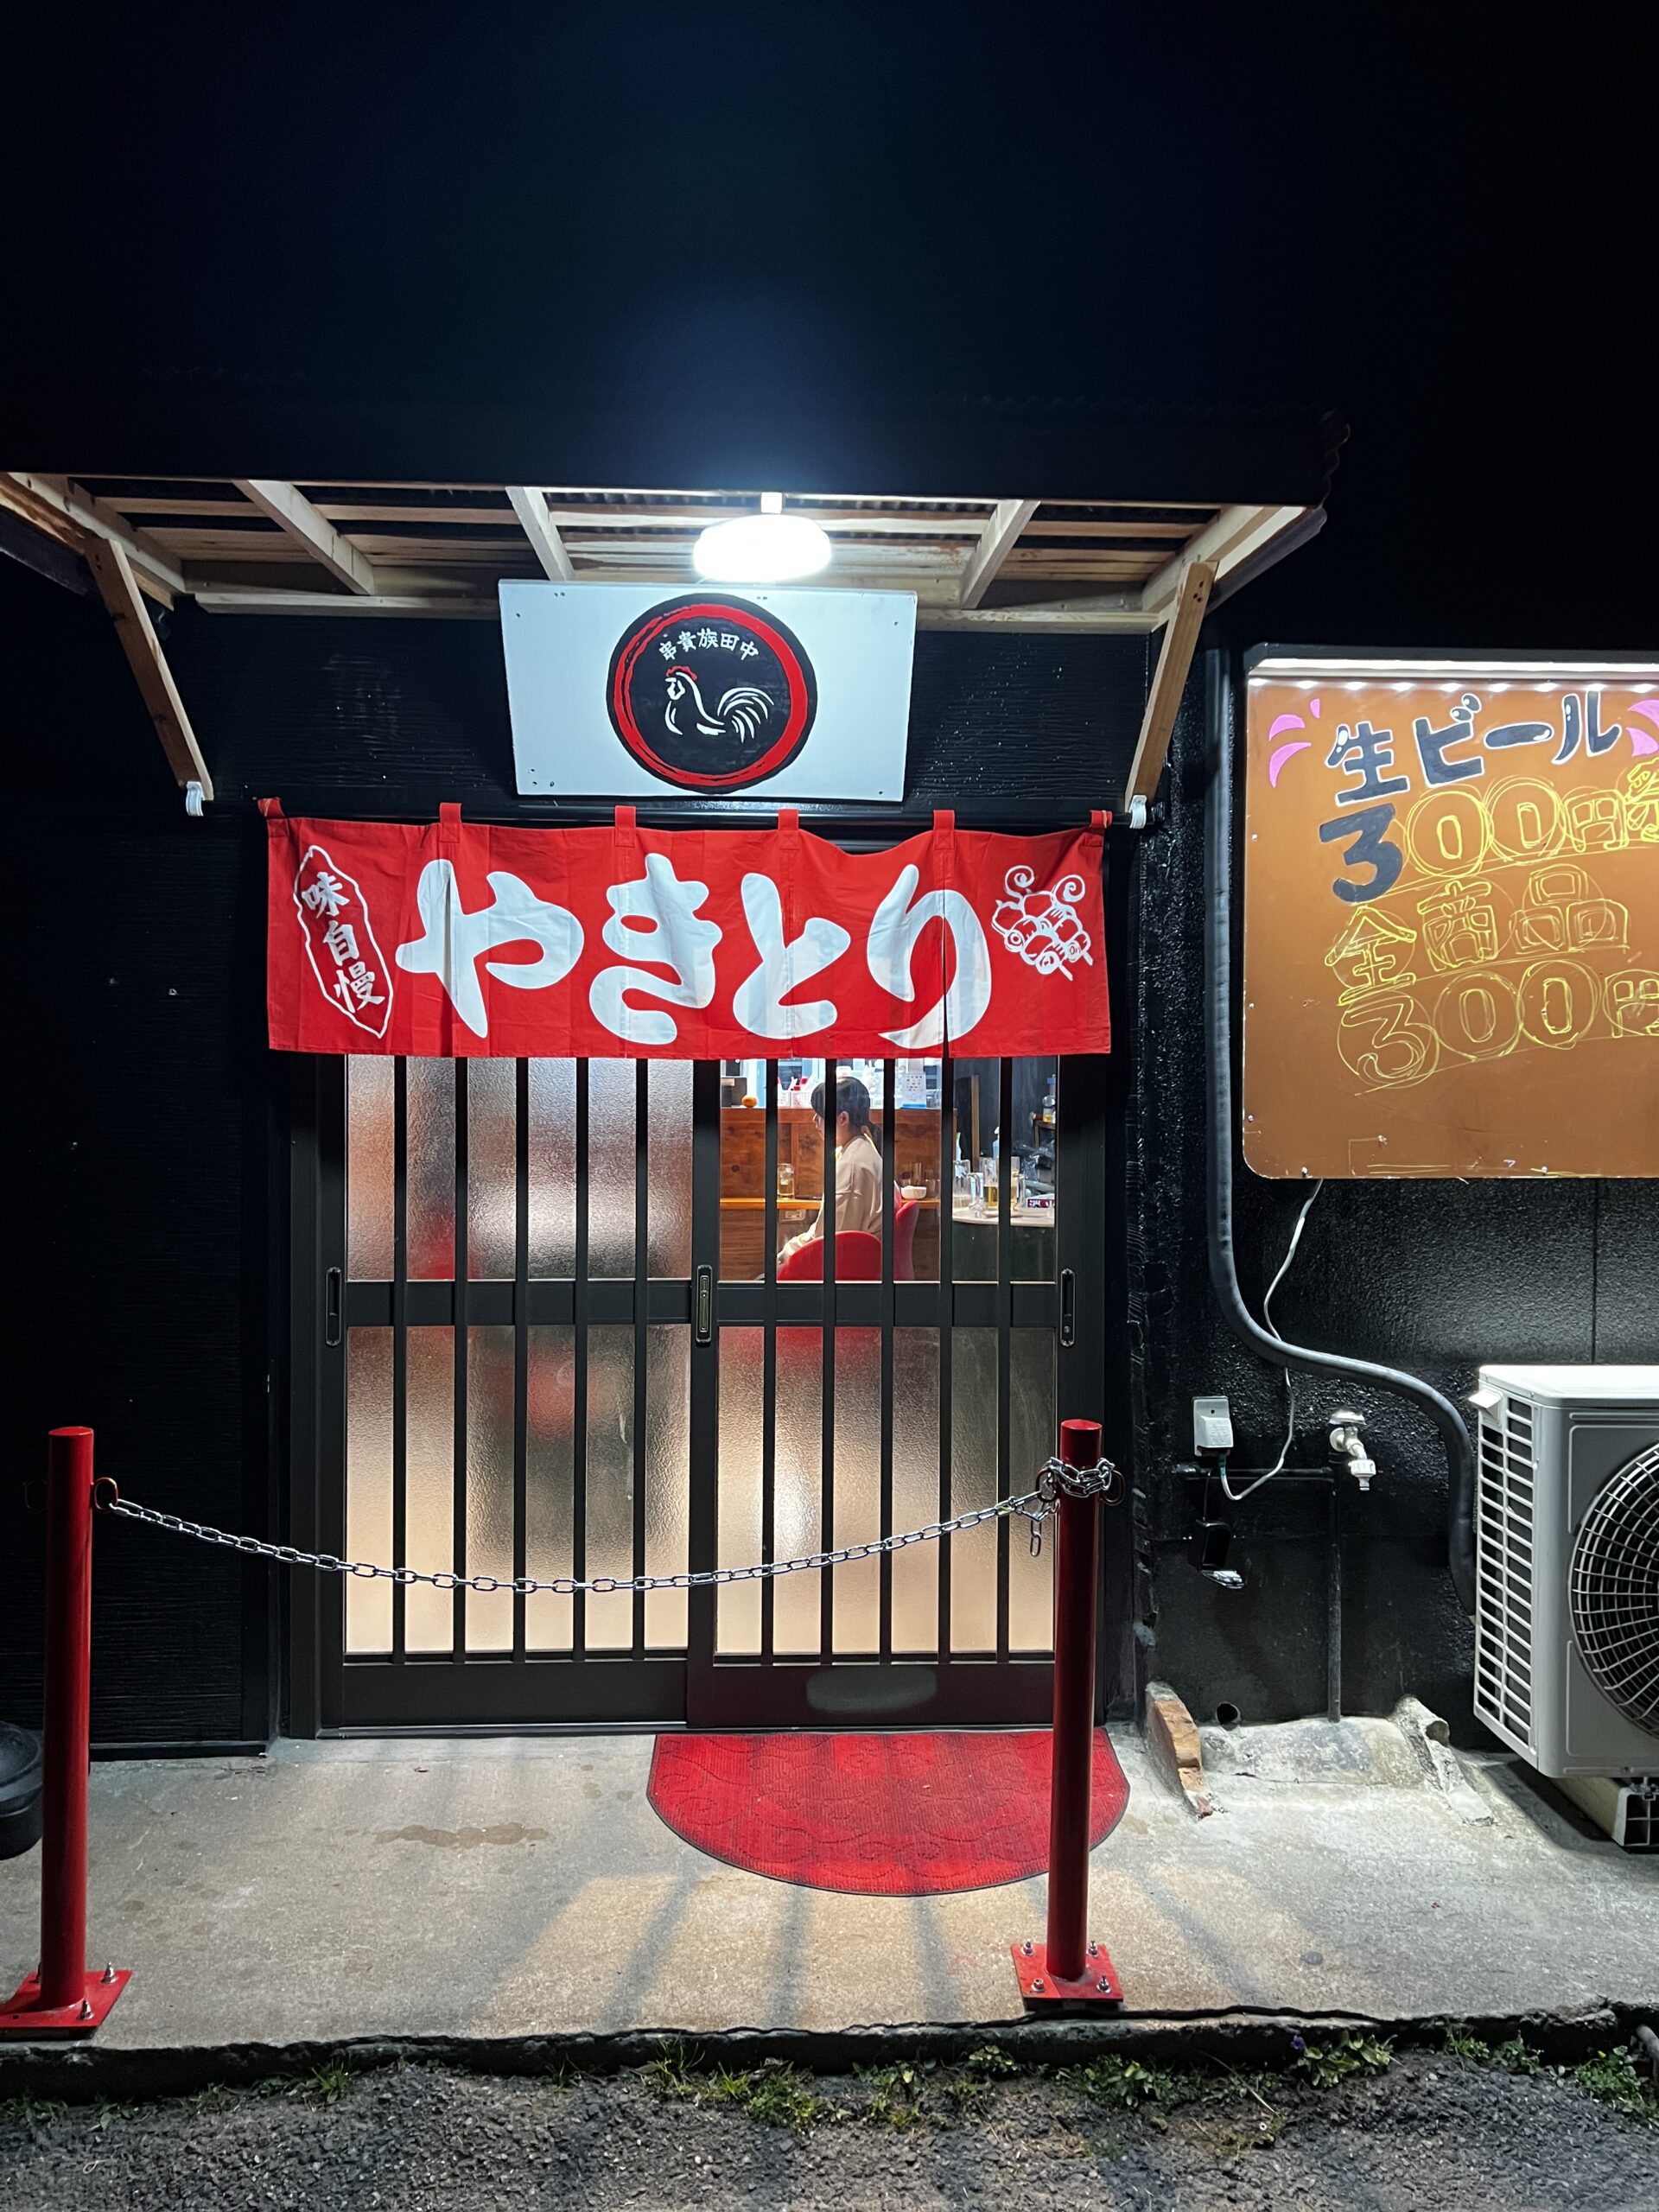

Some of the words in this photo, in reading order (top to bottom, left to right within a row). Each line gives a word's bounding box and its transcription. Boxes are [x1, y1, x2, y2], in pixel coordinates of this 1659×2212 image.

[658, 627, 760, 661] 串貴族田中
[1325, 691, 1622, 807] 生ビール
[302, 871, 386, 1014] 味自慢
[395, 852, 991, 1050] やきとり
[1324, 868, 1630, 1006] 全商品
